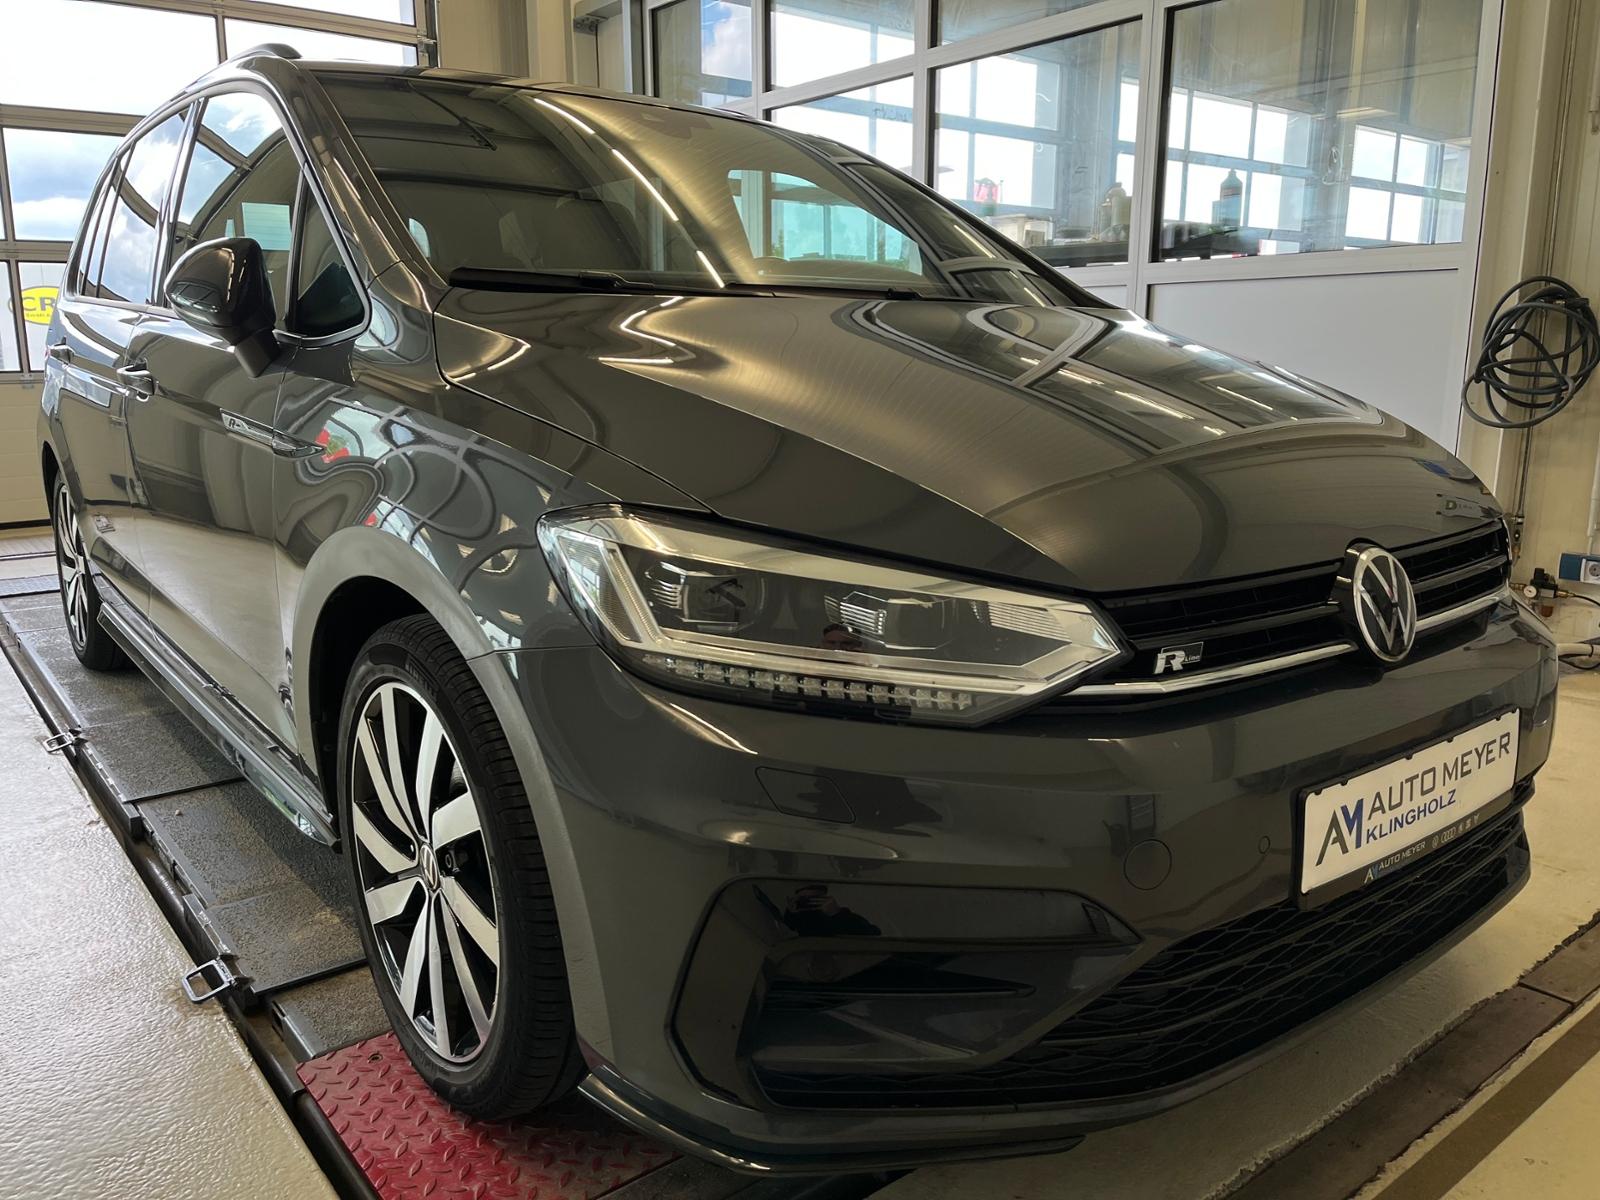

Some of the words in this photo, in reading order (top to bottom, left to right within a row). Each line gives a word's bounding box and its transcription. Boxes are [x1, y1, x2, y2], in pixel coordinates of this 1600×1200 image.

[1367, 766, 1437, 820] AUTO
[1442, 731, 1512, 787] MEYER
[1366, 789, 1457, 844] KLINGHOLZ
[1378, 854, 1401, 870] AUTO
[1401, 841, 1426, 860] MEYER
